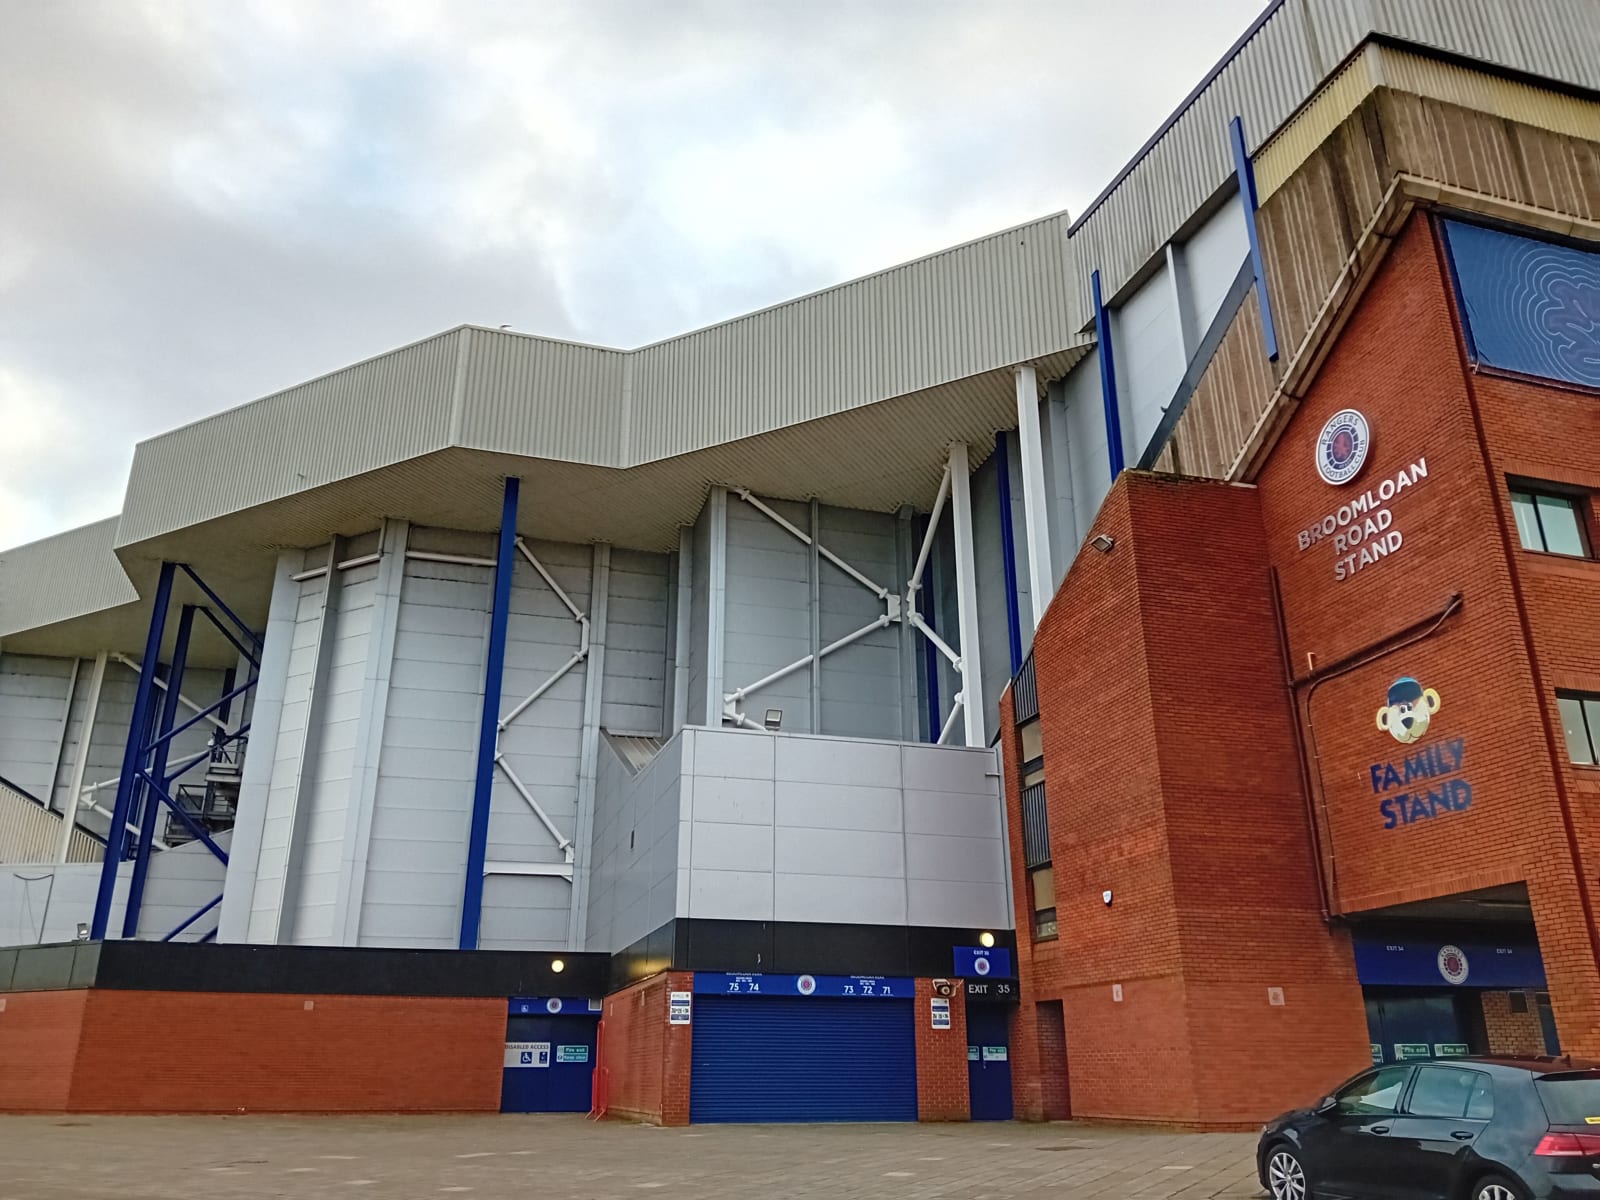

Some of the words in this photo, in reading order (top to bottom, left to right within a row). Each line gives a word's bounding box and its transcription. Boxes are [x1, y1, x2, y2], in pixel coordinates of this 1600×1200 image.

[1321, 414, 1359, 446] RANGERS
[1323, 463, 1355, 479] FOOTBALL
[1354, 439, 1365, 464] CLUB
[1297, 457, 1429, 551] BROOMLOAN
[1334, 509, 1392, 555] ROAD
[1335, 530, 1403, 581] STAND
[1370, 737, 1464, 794] FAMILY
[1380, 779, 1472, 830] STAND
[729, 982, 739, 991] 75
[749, 983, 759, 991] 74
[844, 985, 854, 994] 73
[863, 985, 873, 994] 72
[882, 986, 890, 994] 71
[968, 984, 988, 994] EXIT
[998, 984, 1010, 994] 35
